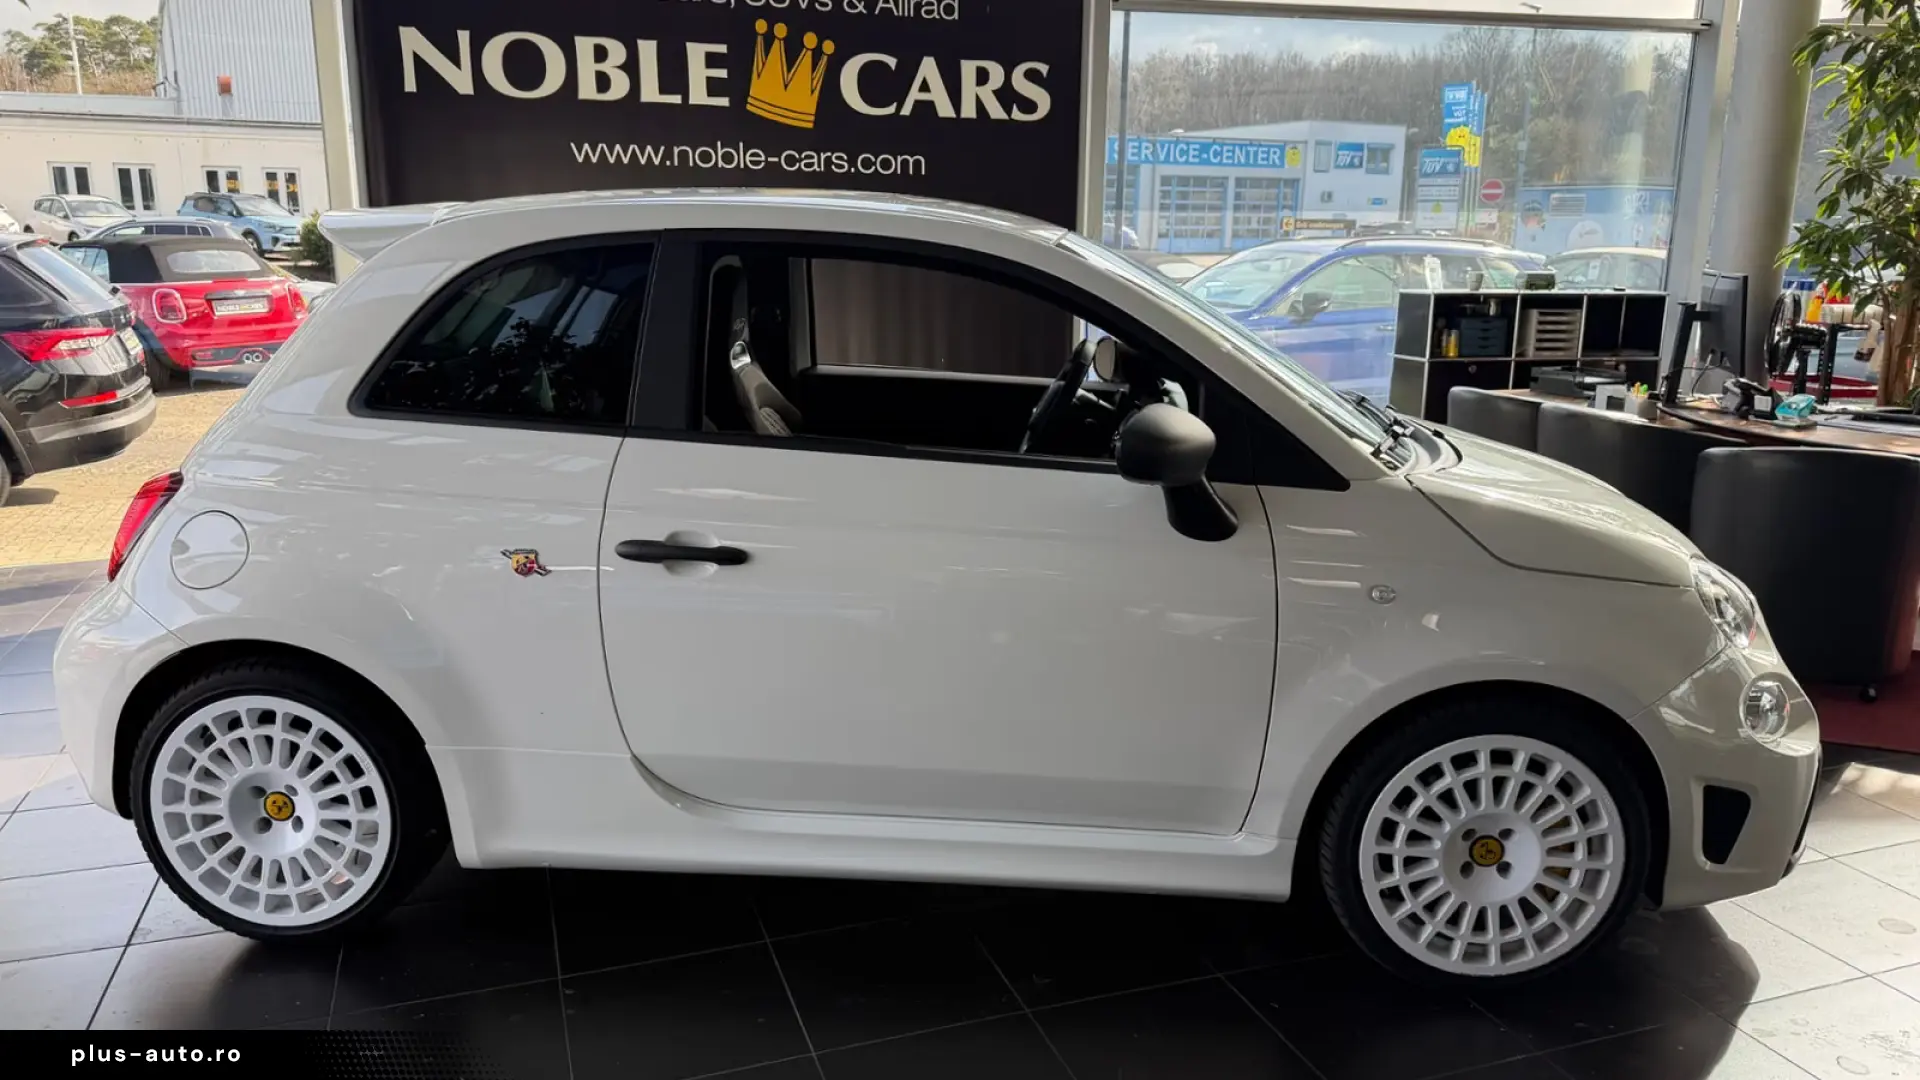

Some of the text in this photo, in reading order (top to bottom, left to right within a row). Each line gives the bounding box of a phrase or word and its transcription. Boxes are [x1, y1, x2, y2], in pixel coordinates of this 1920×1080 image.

[399, 26, 1051, 121] NOBLE CARS
[570, 141, 925, 176] www.noble-cars.com
